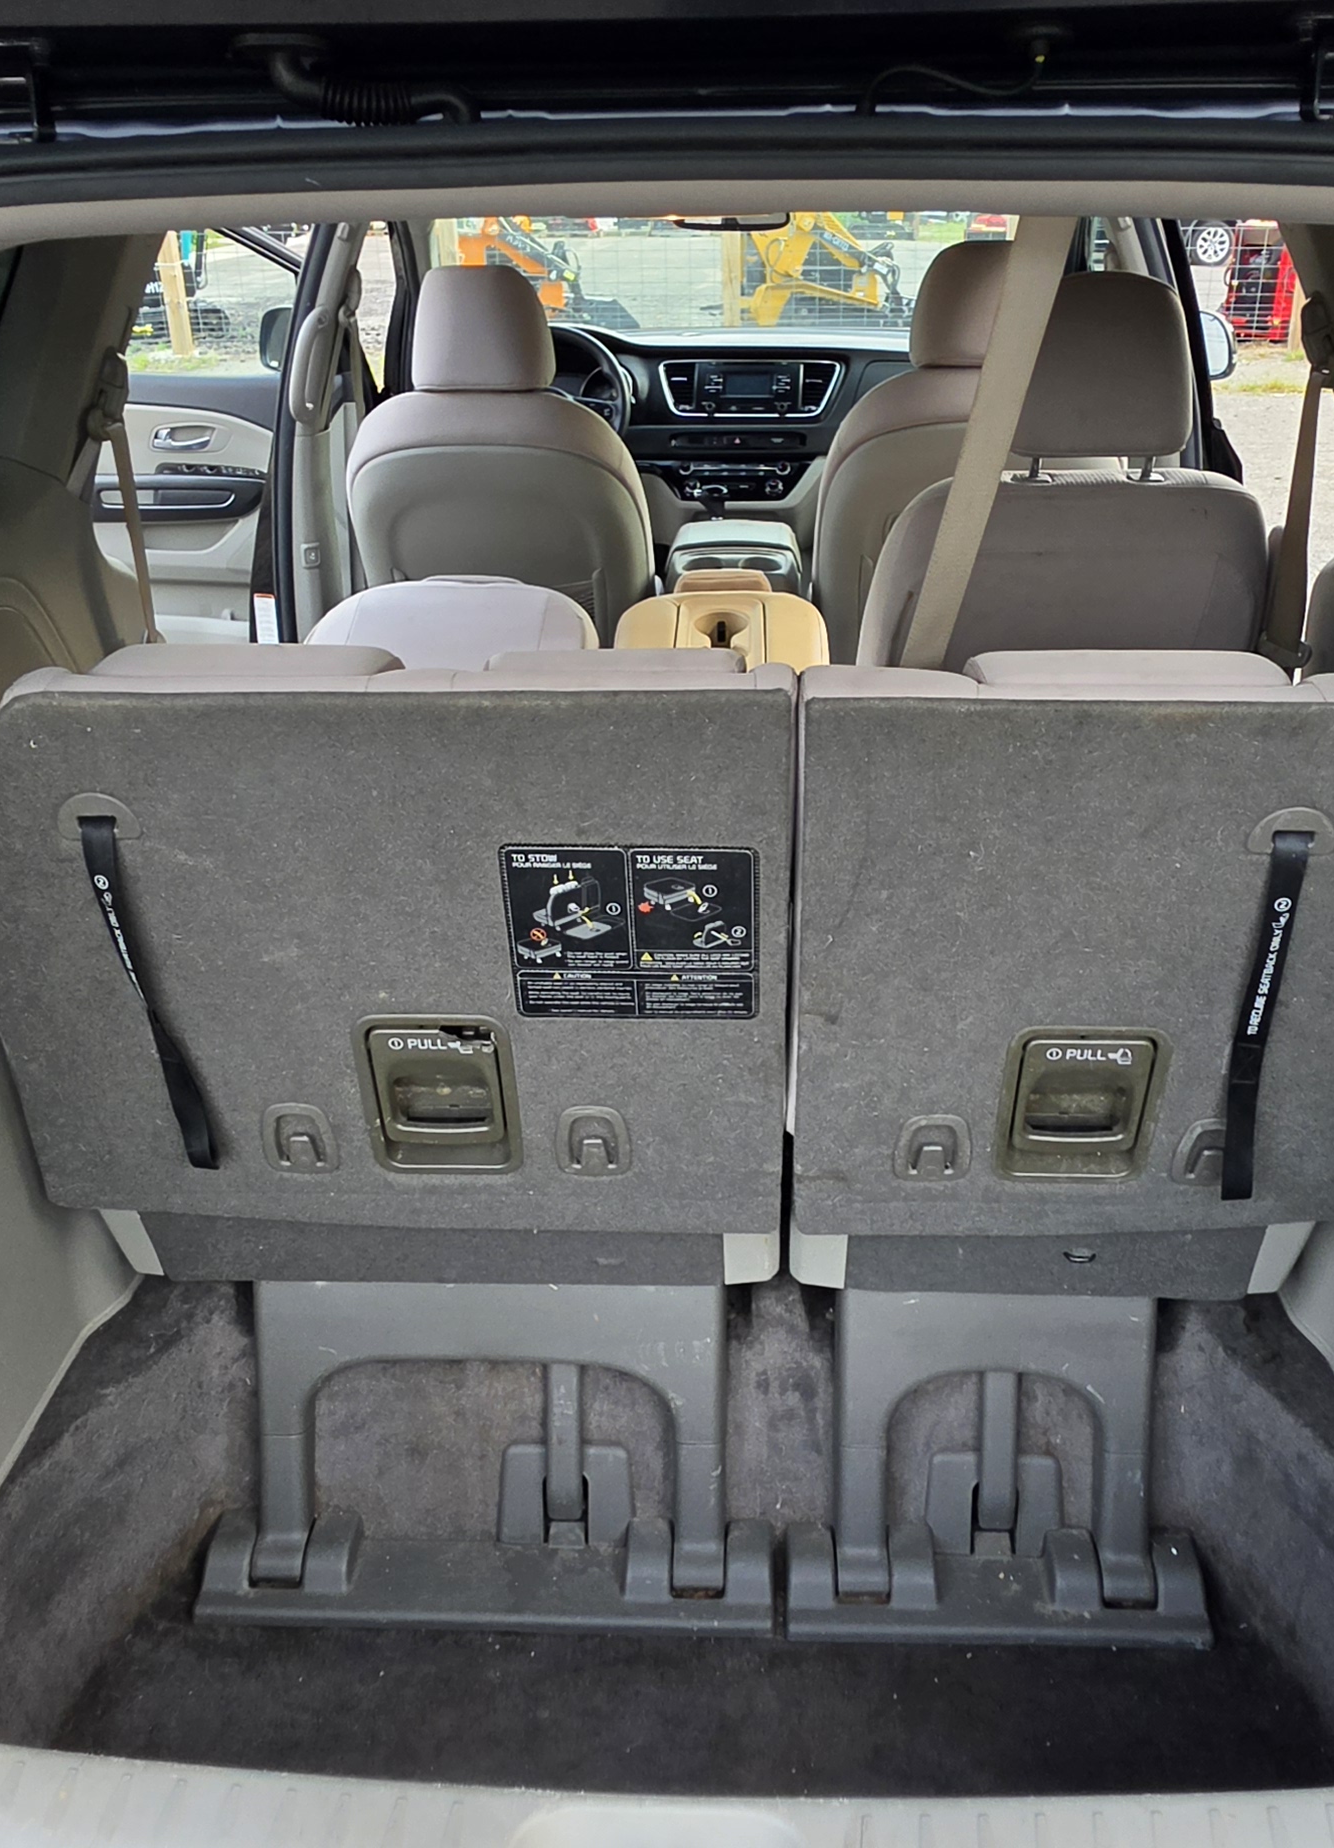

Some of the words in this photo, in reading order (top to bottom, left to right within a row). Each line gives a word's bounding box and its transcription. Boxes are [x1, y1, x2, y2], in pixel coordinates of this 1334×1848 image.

[511, 853, 525, 862] TO
[528, 853, 557, 862] STOW
[636, 854, 650, 864] TO
[653, 854, 673, 864] USE
[676, 854, 704, 864] SEAT
[1258, 951, 1278, 995] SEATBACK
[1269, 929, 1283, 951] ONLY
[407, 1038, 448, 1050] PULL
[1066, 1048, 1107, 1061] PULL
